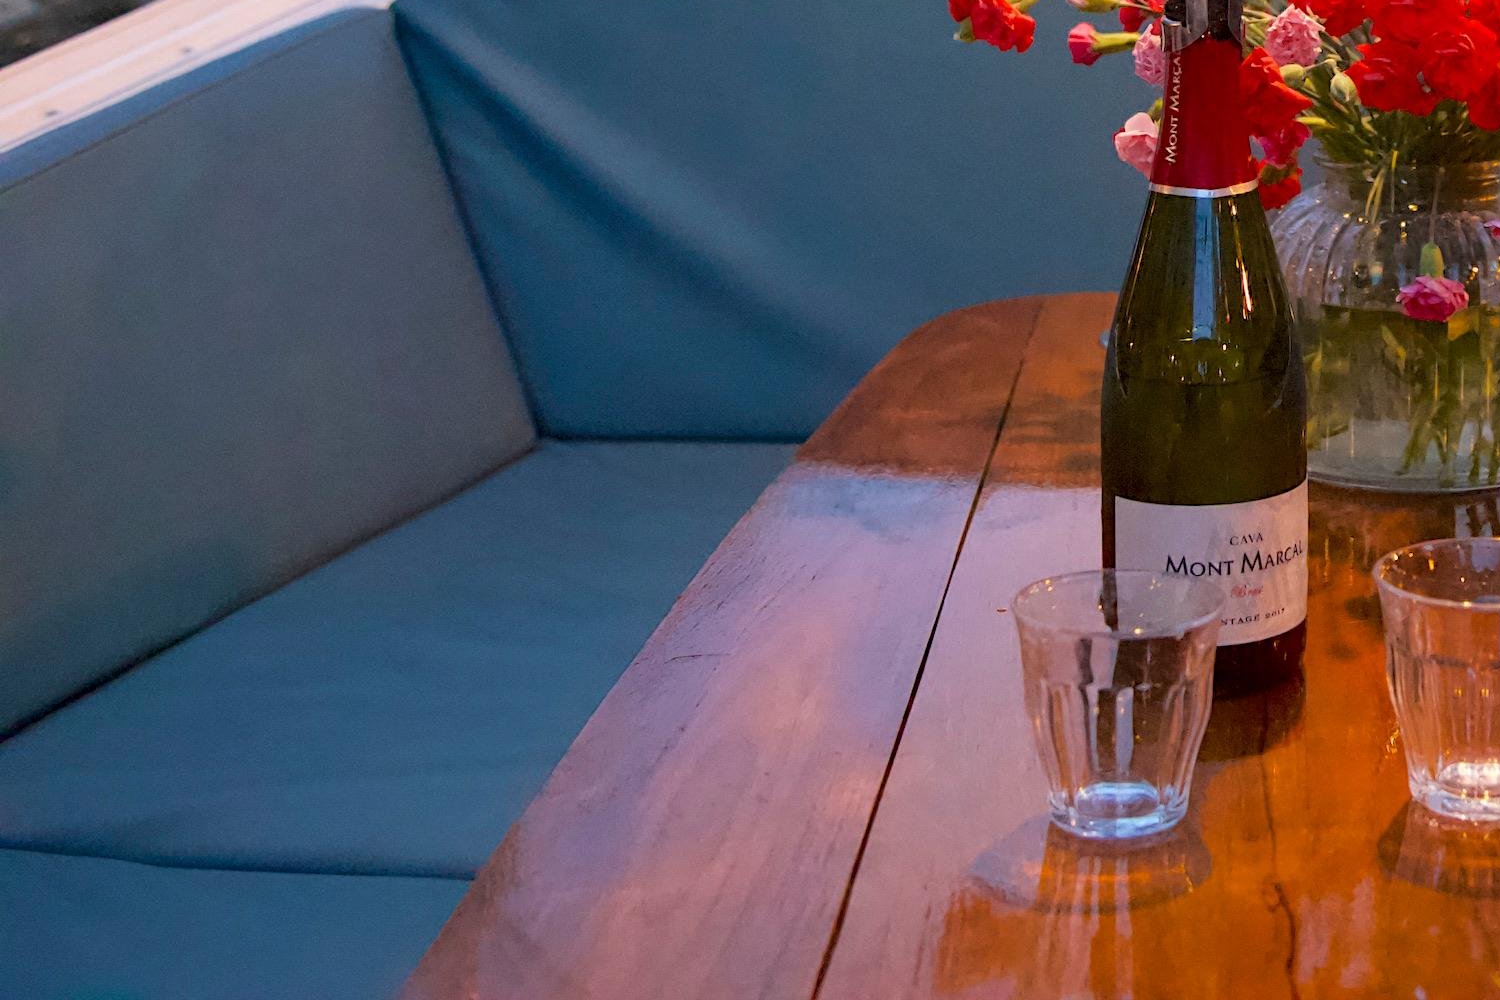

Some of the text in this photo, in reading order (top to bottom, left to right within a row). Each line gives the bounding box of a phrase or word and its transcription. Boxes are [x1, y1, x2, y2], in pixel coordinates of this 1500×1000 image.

[1165, 114, 1179, 163] MONT
[1229, 532, 1263, 546] CAVA
[1165, 555, 1234, 577] MONT
[1221, 614, 1260, 625] NTAGE
